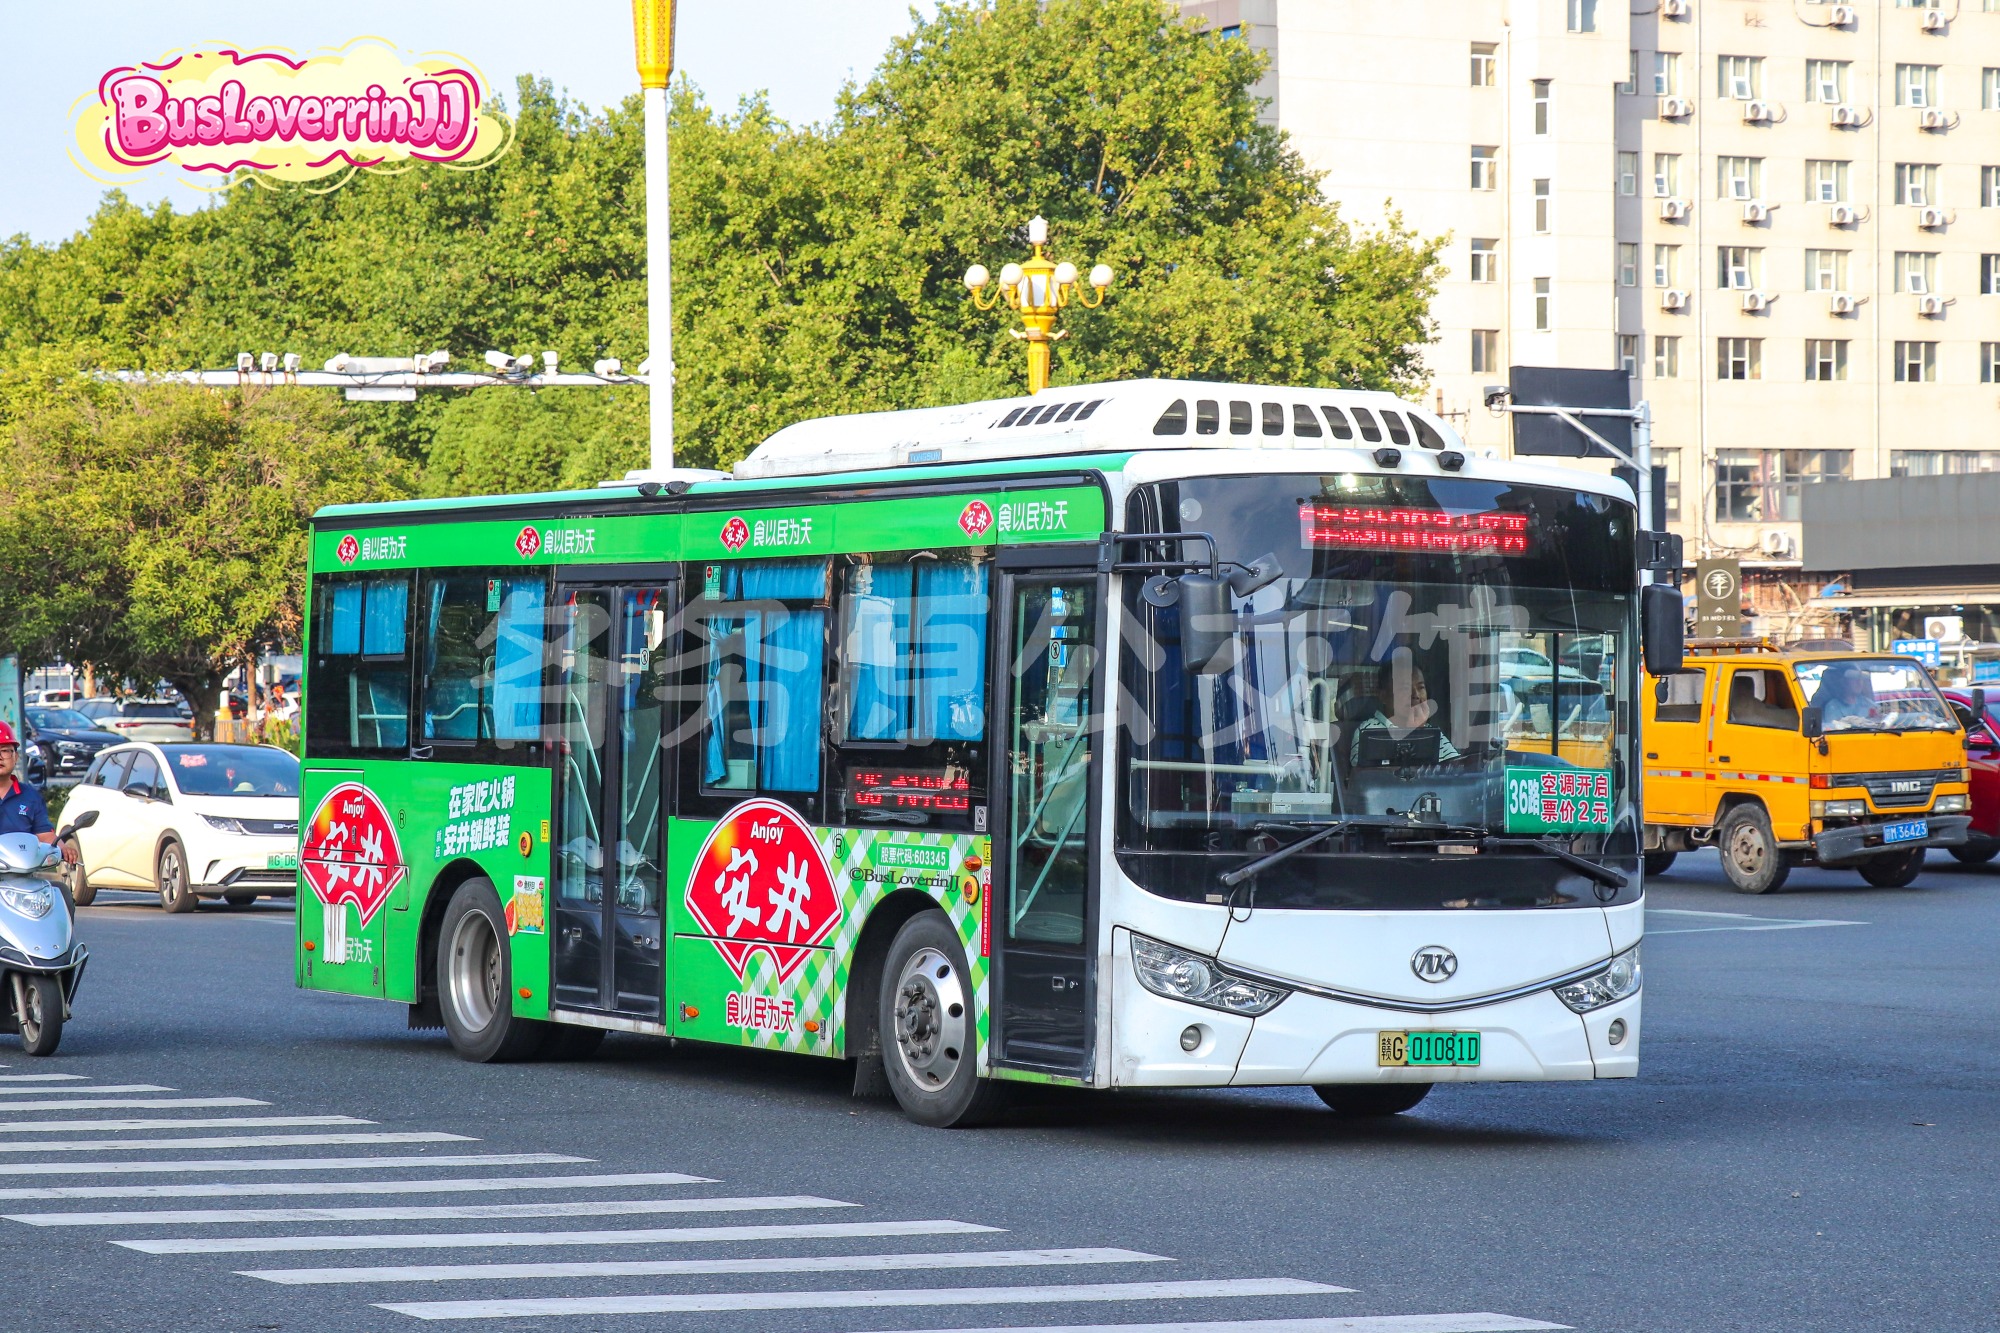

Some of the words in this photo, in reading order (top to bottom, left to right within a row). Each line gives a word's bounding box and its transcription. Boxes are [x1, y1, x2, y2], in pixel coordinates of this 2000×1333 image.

[998, 501, 1067, 532] 食以民为天
[544, 529, 595, 554] 食以民为天
[753, 518, 812, 546] 食以民为天
[361, 536, 406, 560] 食以民为天
[449, 775, 515, 819] 在家吃火锅
[1510, 779, 1540, 815] 36路
[1541, 772, 1609, 799] 空调开启
[342, 796, 366, 818] Anjoy
[443, 814, 511, 857] 安井锁鲜装
[750, 815, 784, 844] Anjoy
[726, 992, 796, 1034] 食以民为天
